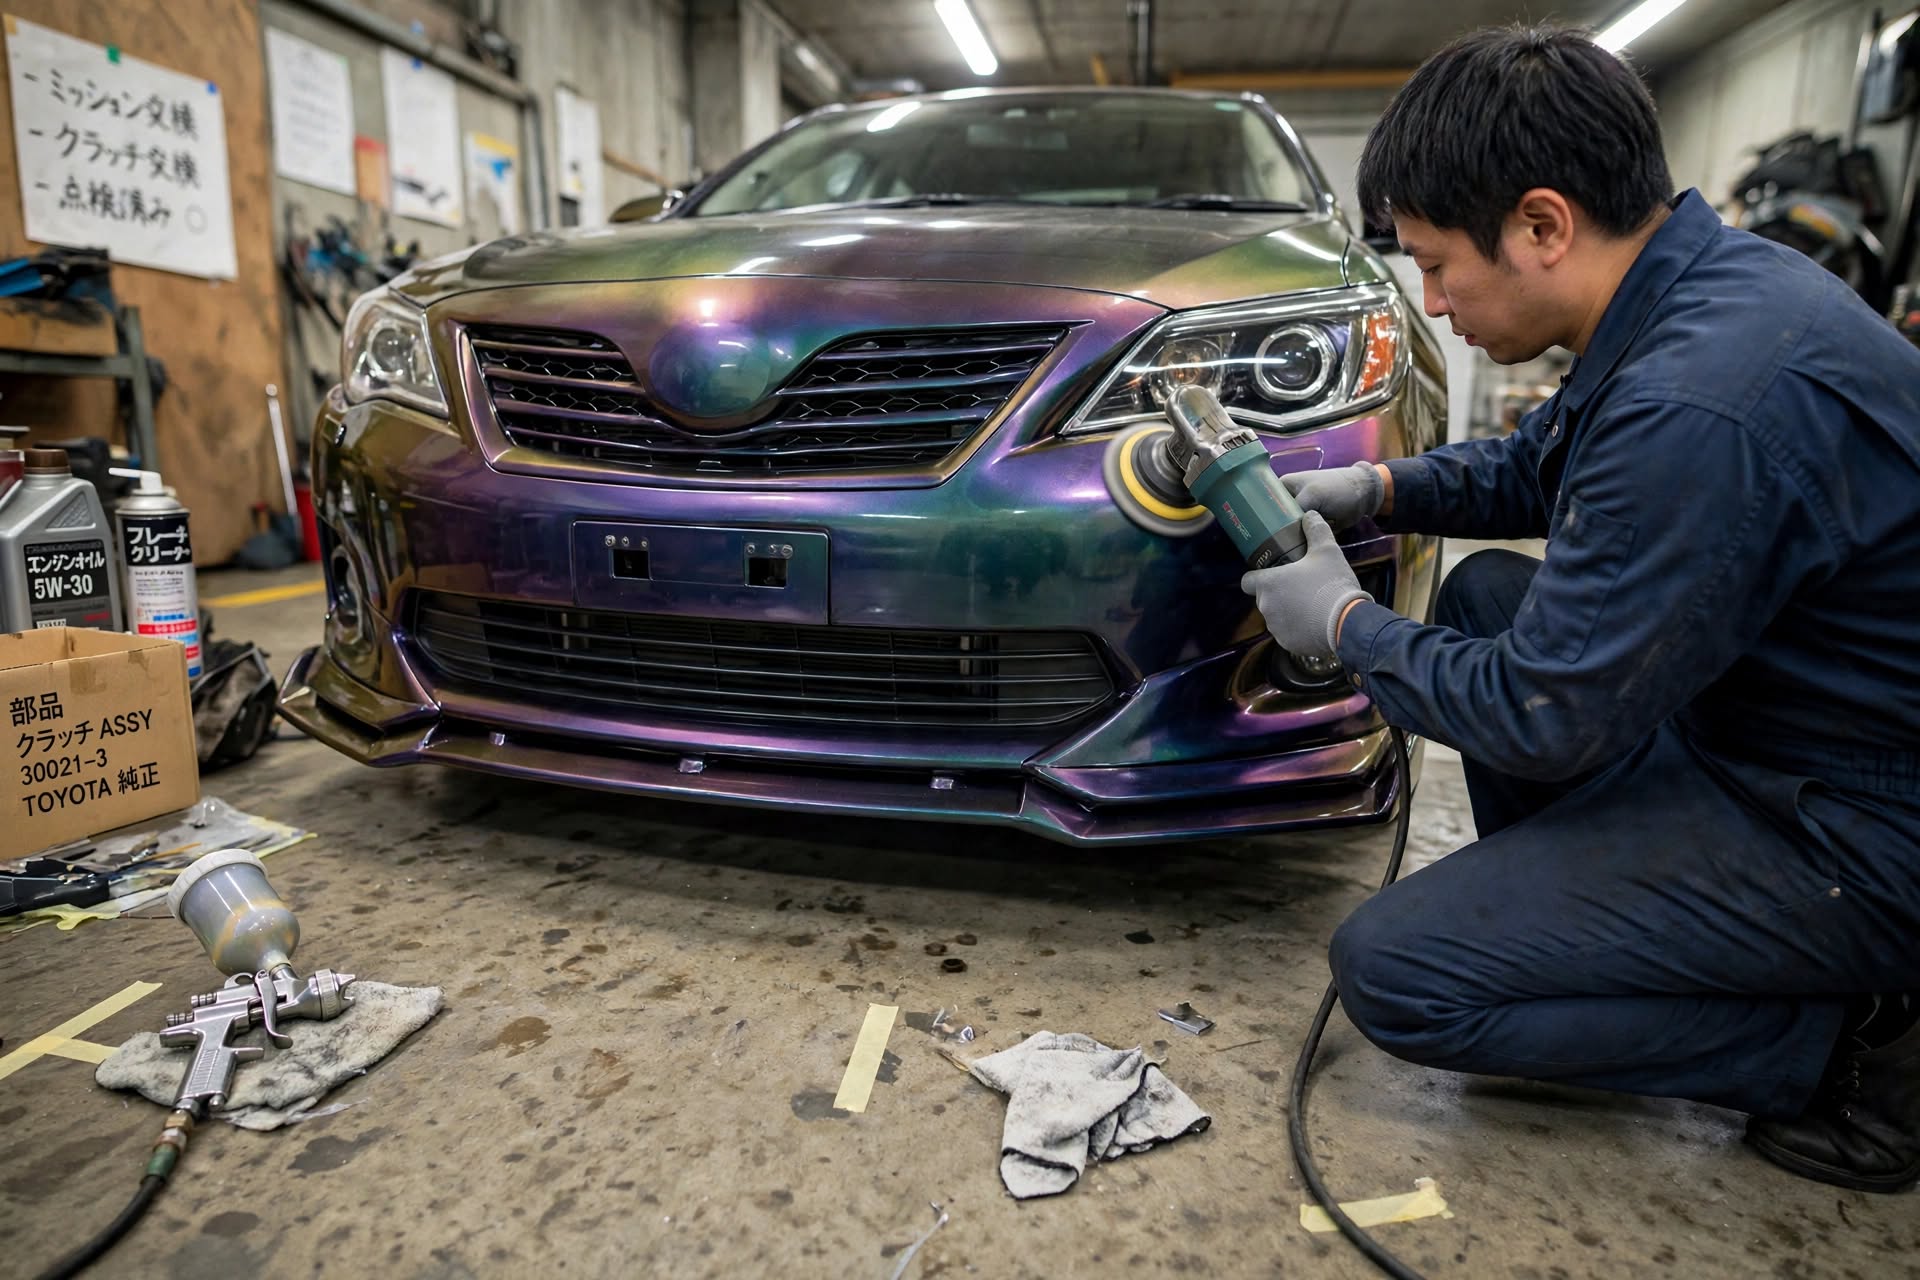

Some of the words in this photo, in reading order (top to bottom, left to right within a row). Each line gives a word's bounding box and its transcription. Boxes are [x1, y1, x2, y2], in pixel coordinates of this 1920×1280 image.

[27, 551, 105, 574] エンジンオイル
[34, 574, 93, 599] 5W-30
[10, 692, 63, 727] 部品
[16, 720, 93, 758] クラッチ
[100, 709, 152, 739] ASSY
[21, 748, 107, 785] 30021-3
[22, 777, 112, 816] TOYOTA
[118, 762, 160, 794] 純正
